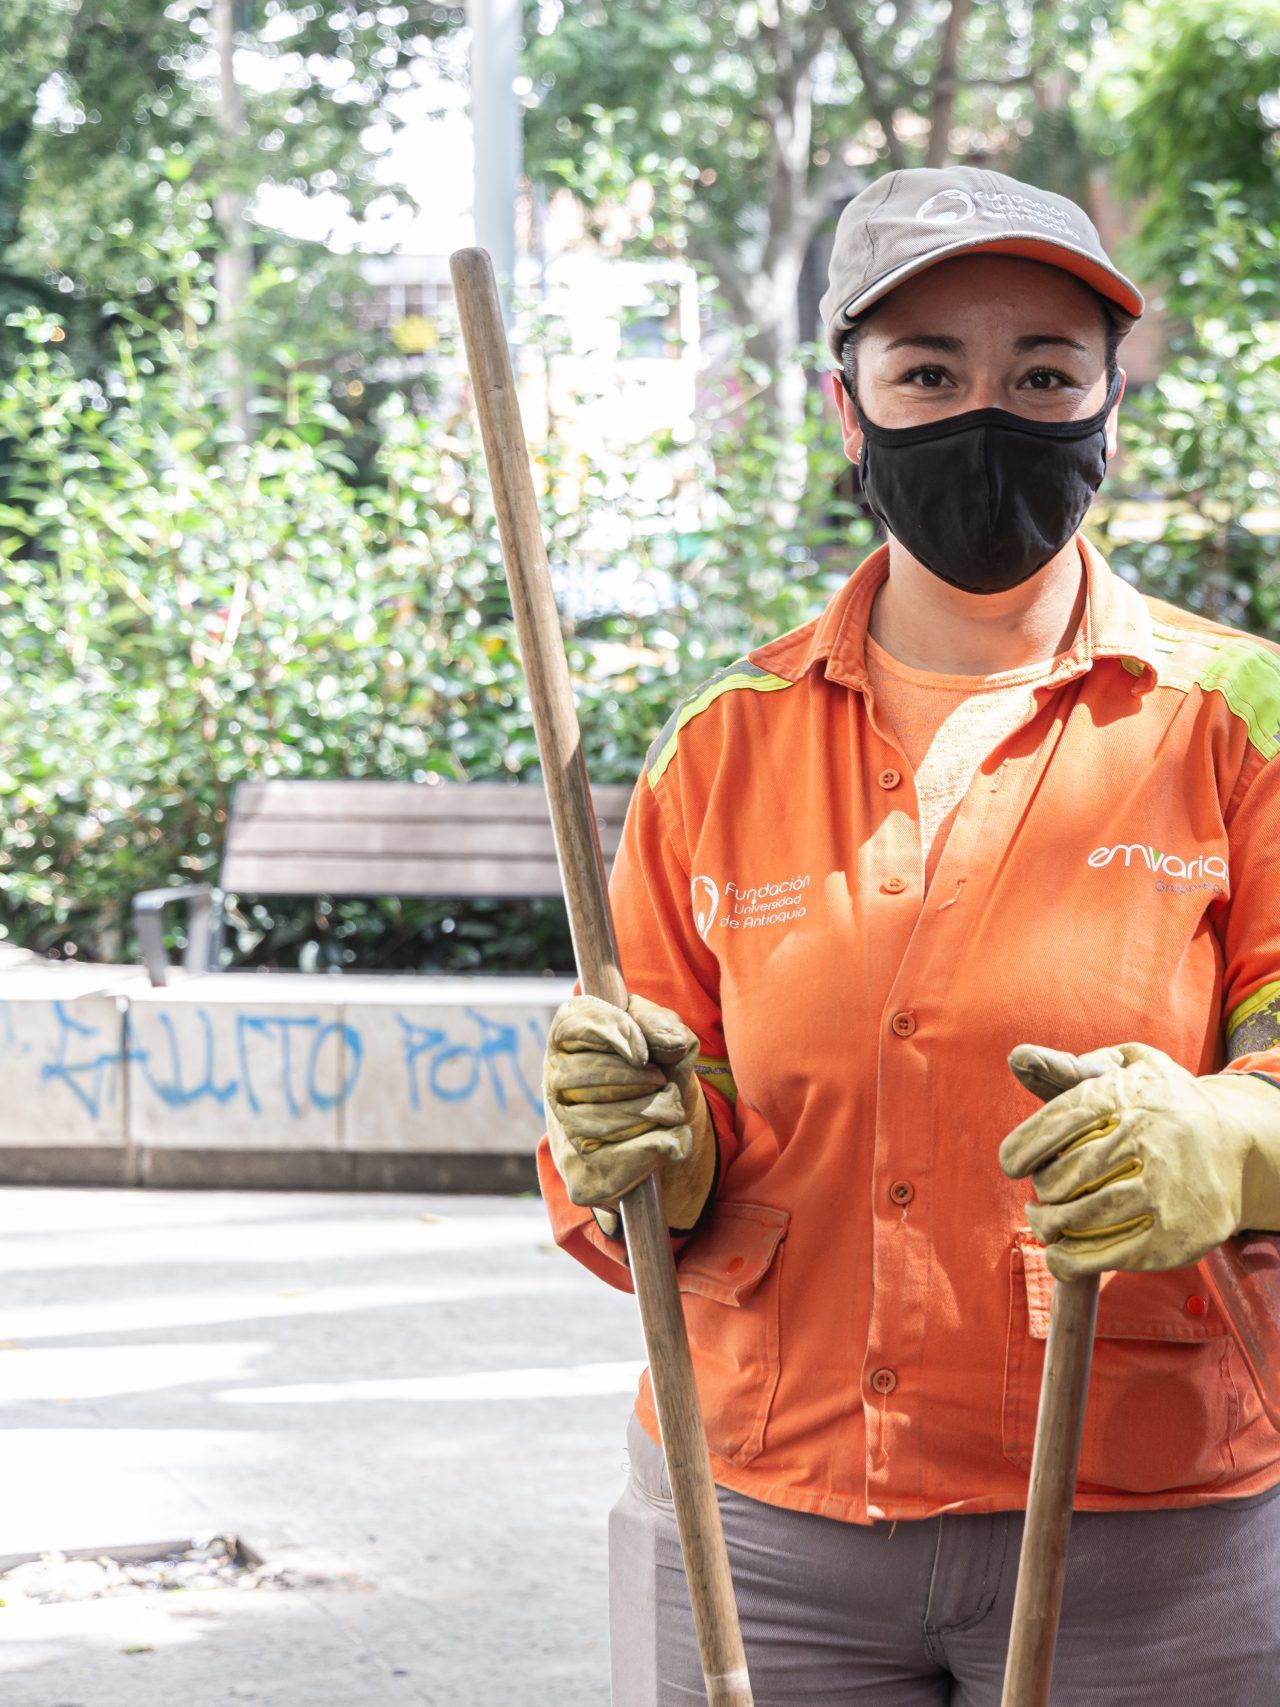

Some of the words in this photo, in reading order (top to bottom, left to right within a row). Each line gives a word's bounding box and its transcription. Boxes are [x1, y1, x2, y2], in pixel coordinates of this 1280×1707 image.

[724, 874, 811, 902] Fundación
[734, 894, 802, 915] Universidad
[719, 914, 739, 929] de
[743, 906, 807, 929] Antioquia
